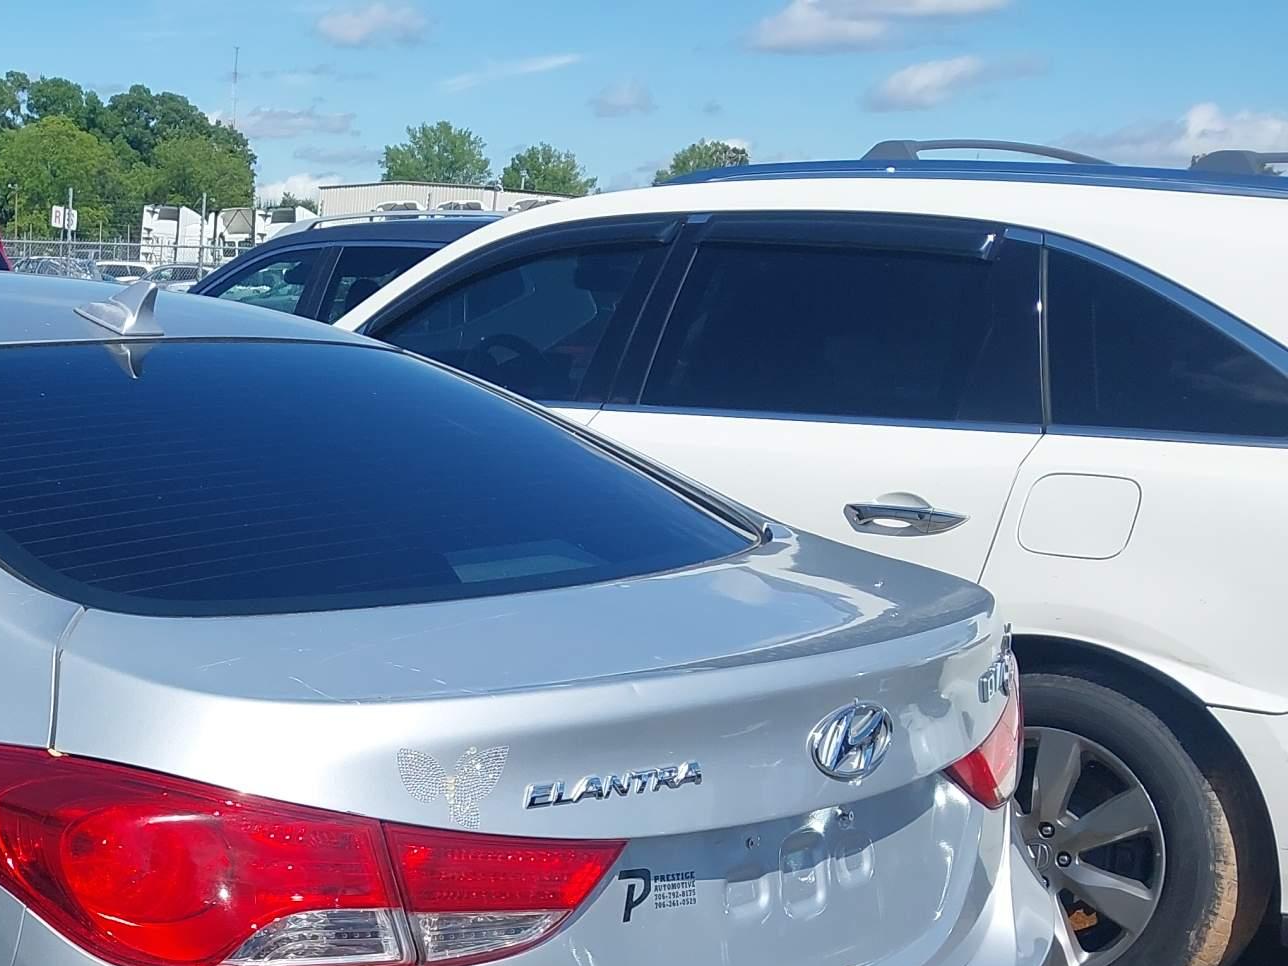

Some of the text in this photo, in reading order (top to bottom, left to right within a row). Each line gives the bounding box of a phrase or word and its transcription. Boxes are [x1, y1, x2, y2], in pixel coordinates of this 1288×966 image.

[54, 210, 61, 225] R
[523, 759, 702, 810] ELANTRA
[654, 871, 696, 883] PRESTIGE
[654, 880, 696, 892] AUTOMOTIVE
[618, 868, 651, 923] P
